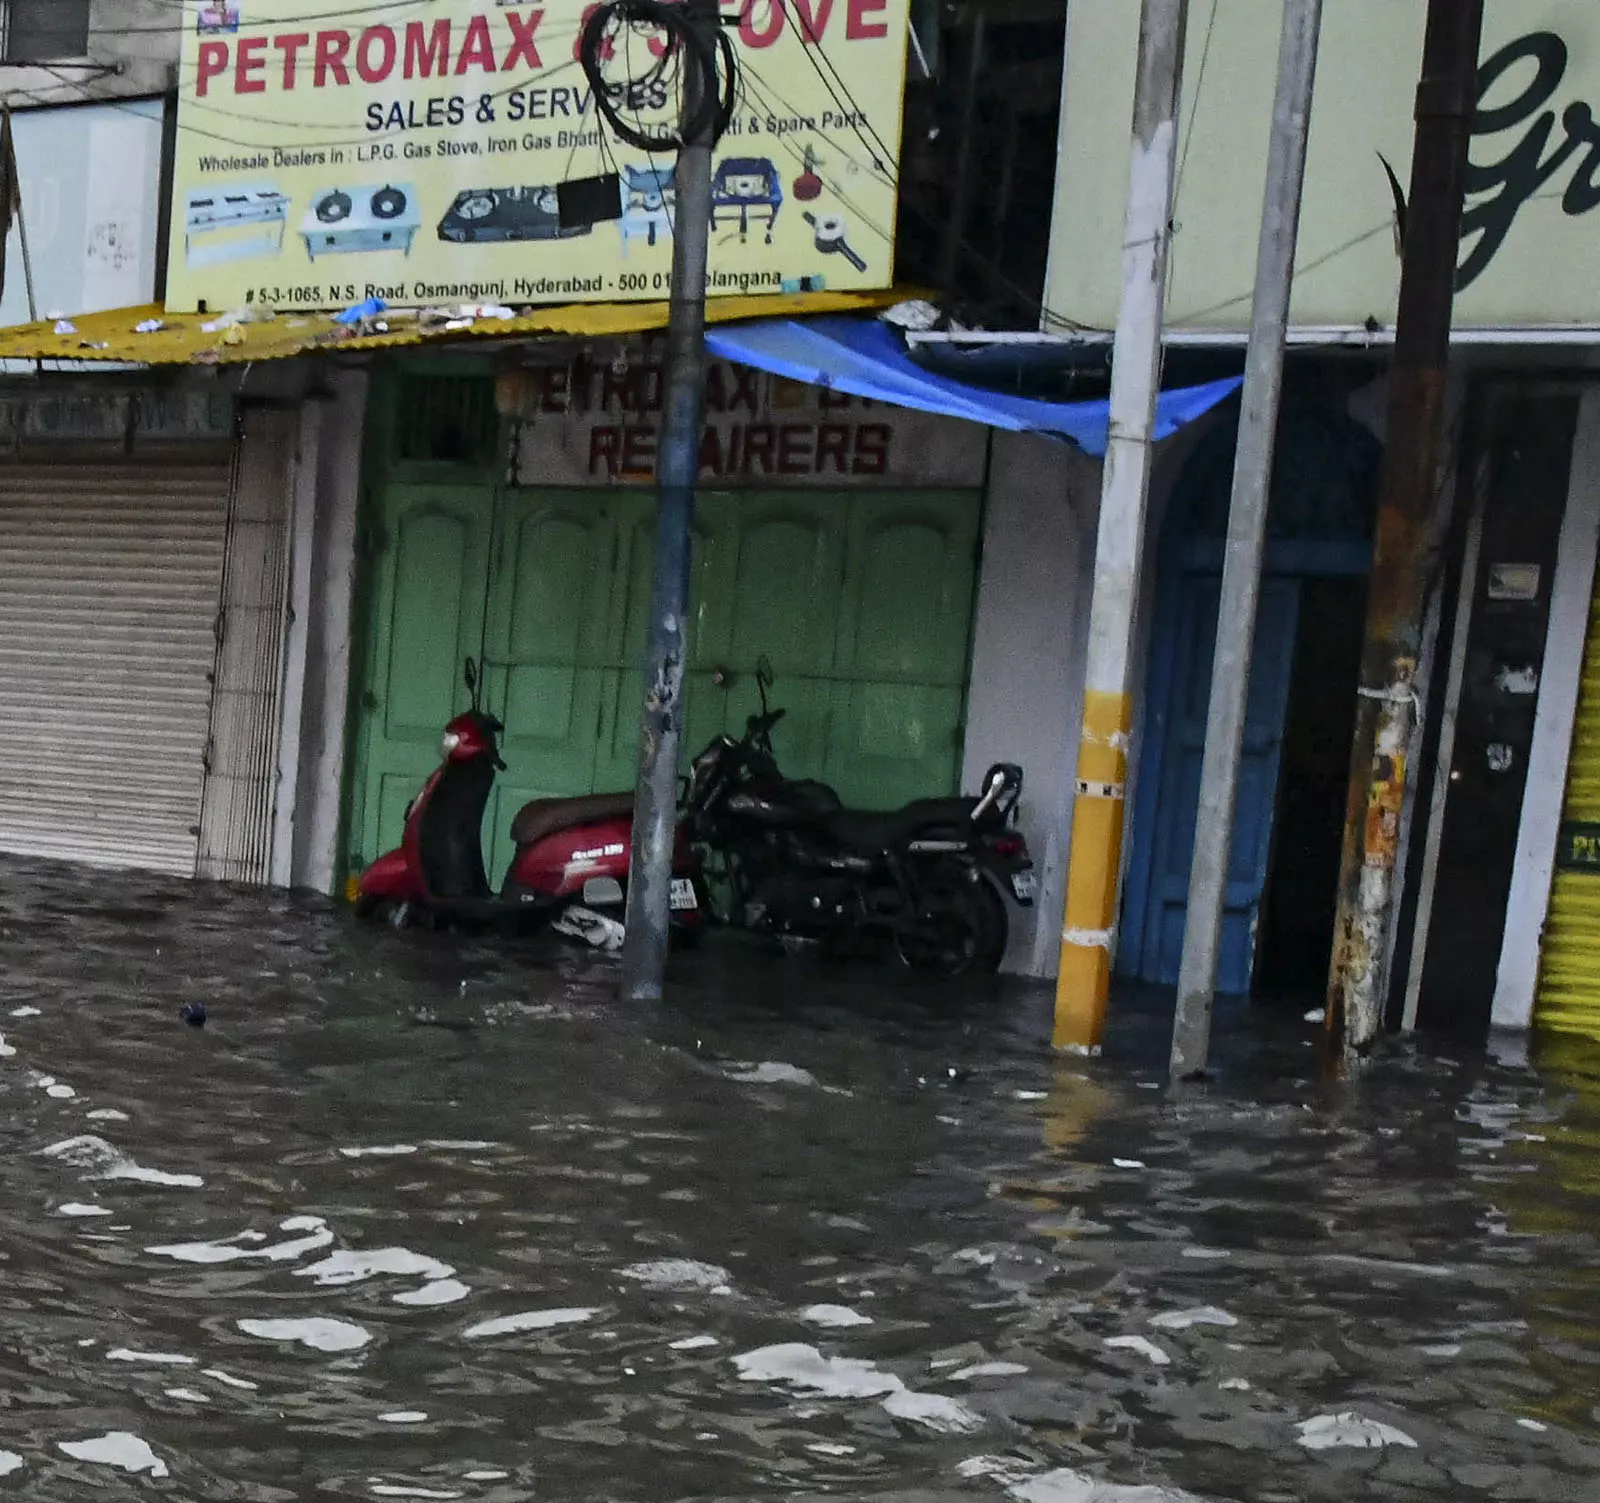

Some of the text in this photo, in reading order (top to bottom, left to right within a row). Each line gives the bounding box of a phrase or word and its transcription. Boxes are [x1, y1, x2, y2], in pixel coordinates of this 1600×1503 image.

[195, 8, 546, 98] PETROMAX
[365, 96, 466, 132] SALES
[475, 93, 496, 124] &
[198, 152, 270, 172] Wholesale
[273, 148, 326, 169] Dealers
[330, 148, 344, 165] in
[357, 144, 398, 162] L.P.G.
[403, 142, 432, 159] Gas
[436, 138, 482, 158] Stove,
[487, 135, 517, 153] Iron
[522, 132, 552, 150] Gas
[748, 115, 760, 133] &
[766, 113, 817, 138] Spare
[821, 110, 868, 130] Parts
[259, 286, 325, 304] 5-3-1065,
[329, 284, 360, 301] N.S.
[365, 283, 409, 301] Road,
[414, 280, 509, 300] Osmangunj,
[513, 275, 603, 298] Hyderabad
[618, 273, 649, 291] 500
[588, 422, 894, 476] REAIRERS
